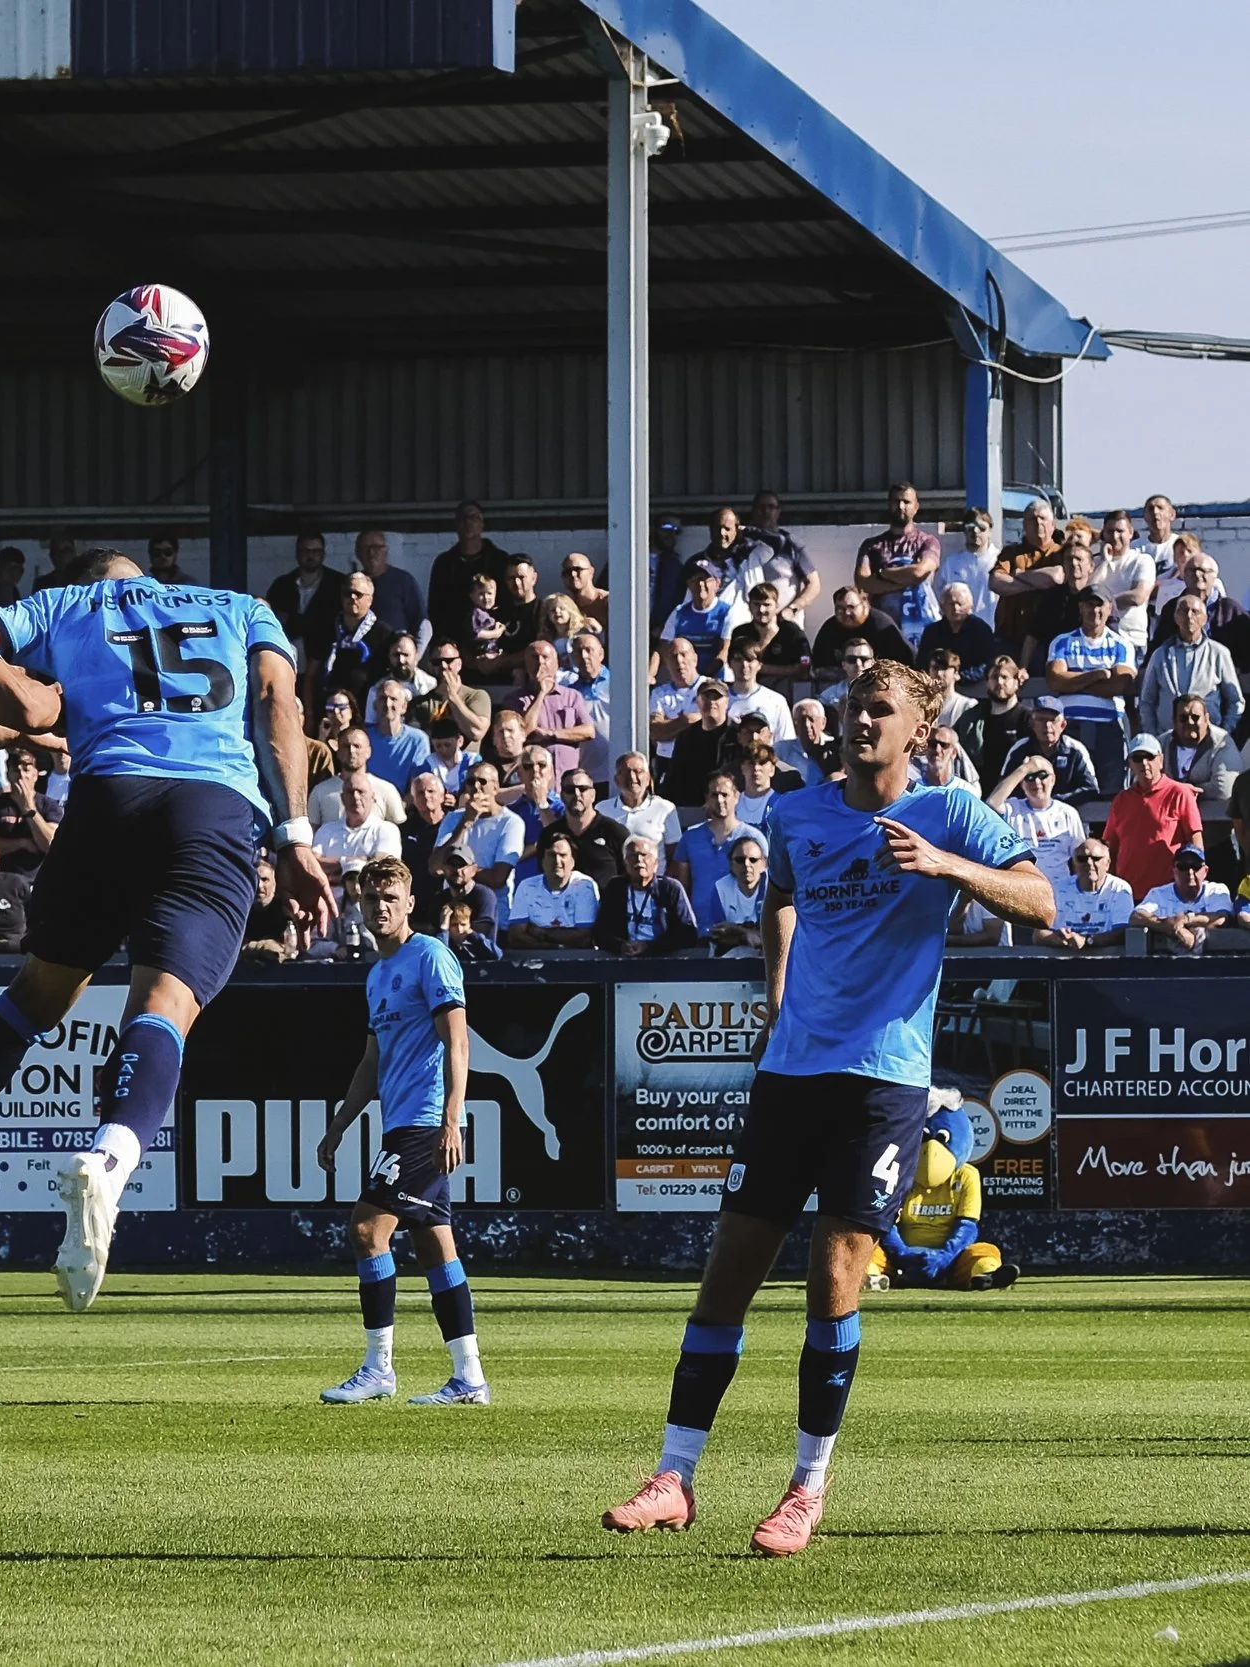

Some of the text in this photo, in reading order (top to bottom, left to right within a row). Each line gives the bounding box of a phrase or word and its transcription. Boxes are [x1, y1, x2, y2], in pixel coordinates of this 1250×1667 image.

[106, 619, 235, 713] 15
[805, 881, 899, 901] MORNFLAKE
[639, 1001, 768, 1030] PAUL'S
[1065, 1028, 1087, 1074] J
[1105, 1028, 1131, 1073] F
[1063, 1080, 1172, 1097] CHARTERED
[636, 1088, 672, 1107] Buy
[677, 1091, 720, 1107] your
[1004, 1097, 1037, 1106] DIRECT
[999, 1109, 1043, 1118] WITH THE
[635, 1113, 710, 1131] comfort
[715, 1113, 735, 1130] of
[1005, 1121, 1037, 1129] FITTER
[636, 1144, 672, 1155] 1000's
[675, 1144, 686, 1155] of
[688, 1145, 723, 1156] carpet
[27, 1159, 51, 1170] Felt
[369, 1150, 401, 1186] 14
[636, 1165, 721, 1174] CARPET VINYL
[872, 1143, 900, 1195] 4
[994, 1159, 1044, 1174] FREE
[1076, 1145, 1149, 1177] More
[1156, 1145, 1218, 1180] than
[636, 1185, 656, 1195] Tel:
[659, 1184, 696, 1195] 01229
[983, 1177, 1044, 1186] ESTIMATING
[988, 1187, 1044, 1196] & PLANNING
